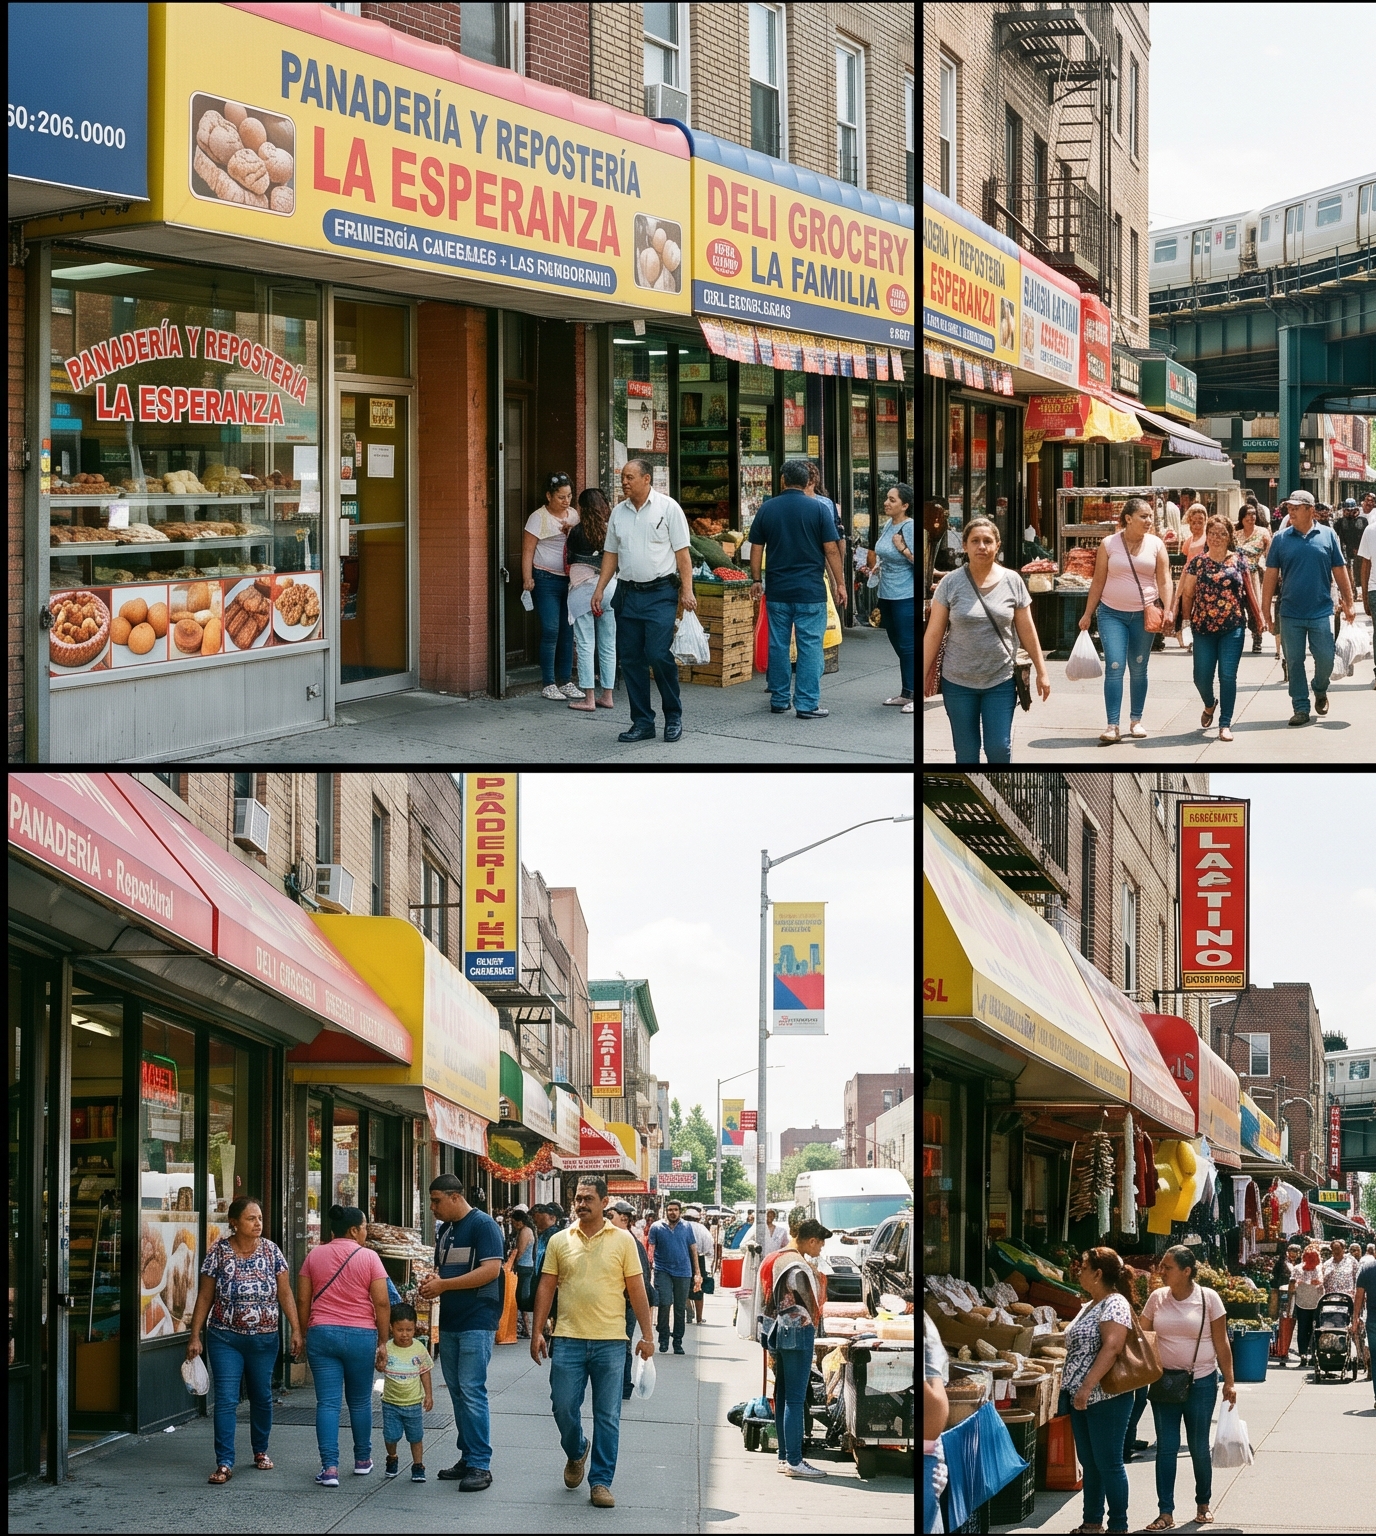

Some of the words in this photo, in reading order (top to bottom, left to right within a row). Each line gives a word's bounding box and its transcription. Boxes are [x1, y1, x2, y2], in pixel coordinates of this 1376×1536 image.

[281, 49, 462, 148] PANADERÍA
[470, 110, 489, 154] Y
[496, 117, 642, 199] REPOSTERÍA
[313, 125, 376, 203] LA
[391, 146, 621, 258] ESPERANZA
[707, 174, 777, 242] DELI
[788, 202, 909, 276] GROCERY
[510, 253, 534, 274] LAS
[751, 245, 784, 289] LA
[791, 257, 880, 311] FAMILIA
[930, 261, 996, 328] ESPERANZA
[64, 317, 183, 393] PANADERÍA
[185, 325, 201, 358] Y
[204, 327, 309, 406] REPOSTERÍA
[96, 383, 134, 422] LA
[138, 384, 285, 426] ESPERANZA
[9, 792, 102, 881] PANADERÍA
